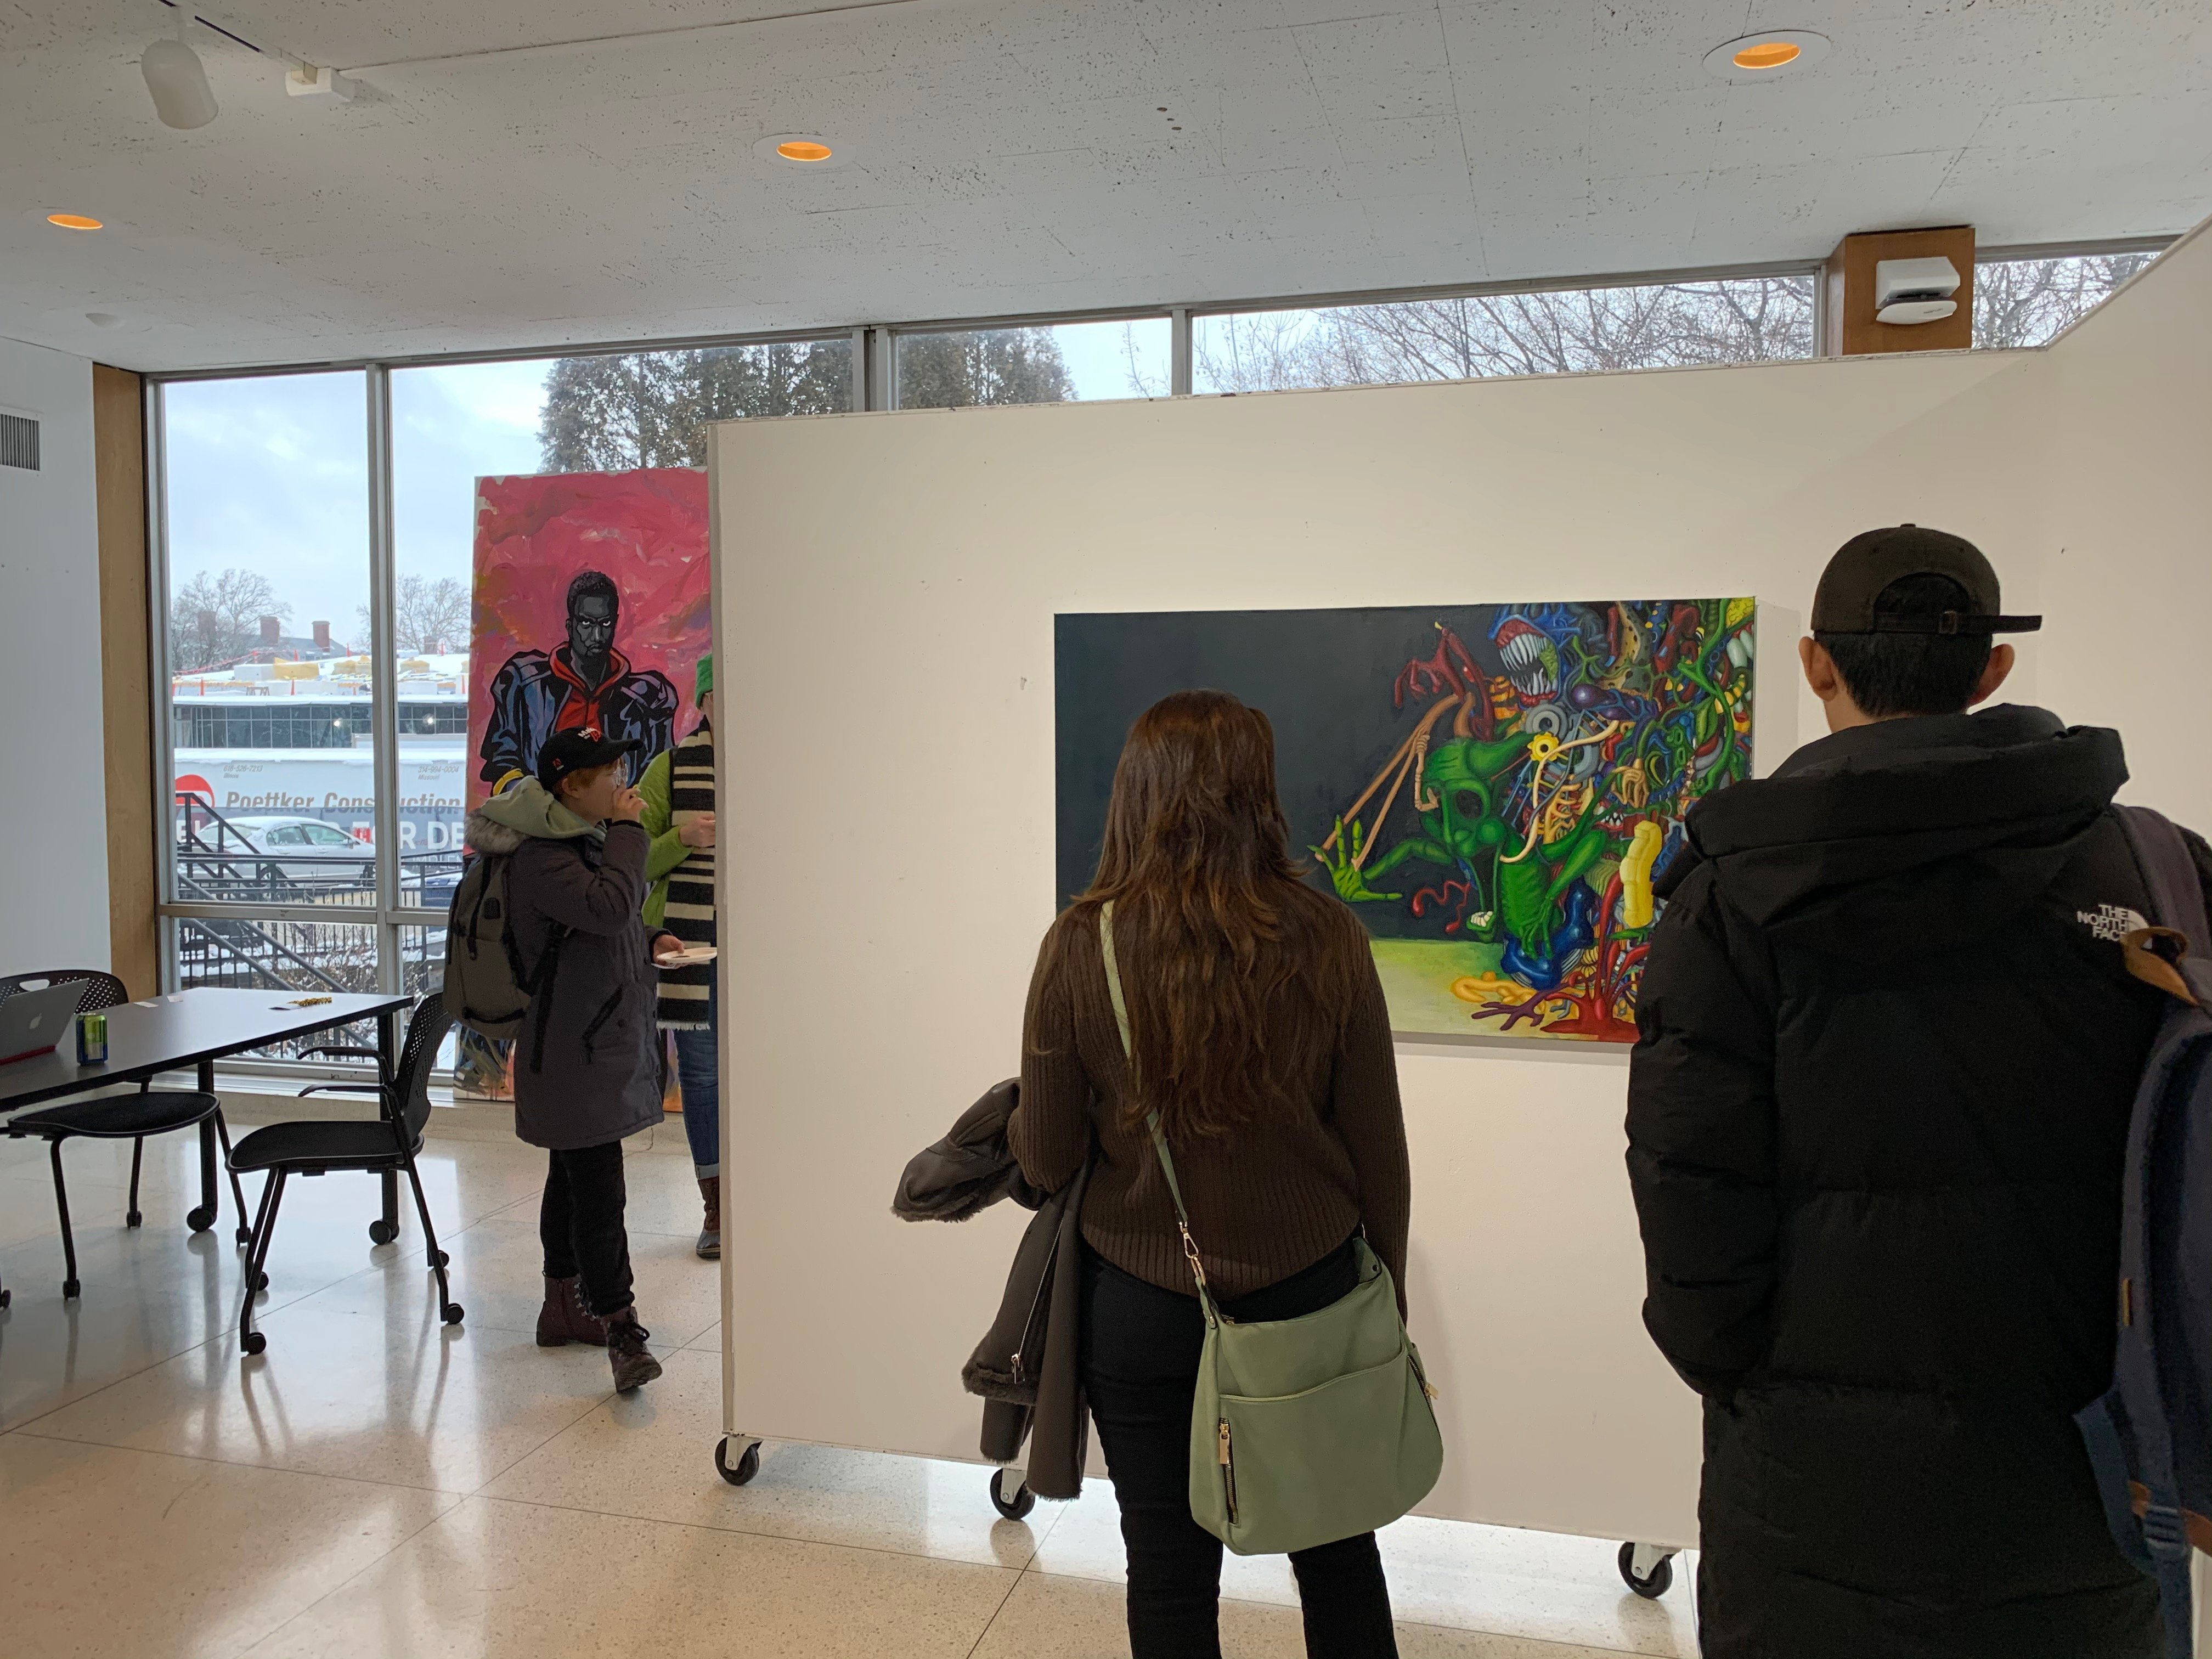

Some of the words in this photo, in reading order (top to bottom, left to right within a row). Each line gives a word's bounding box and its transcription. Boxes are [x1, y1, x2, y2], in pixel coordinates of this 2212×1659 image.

[225, 791, 314, 812] Poettker
[2098, 904, 2129, 918] THE
[2077, 911, 2128, 932] NORTH
[2092, 926, 2125, 941] FAC
